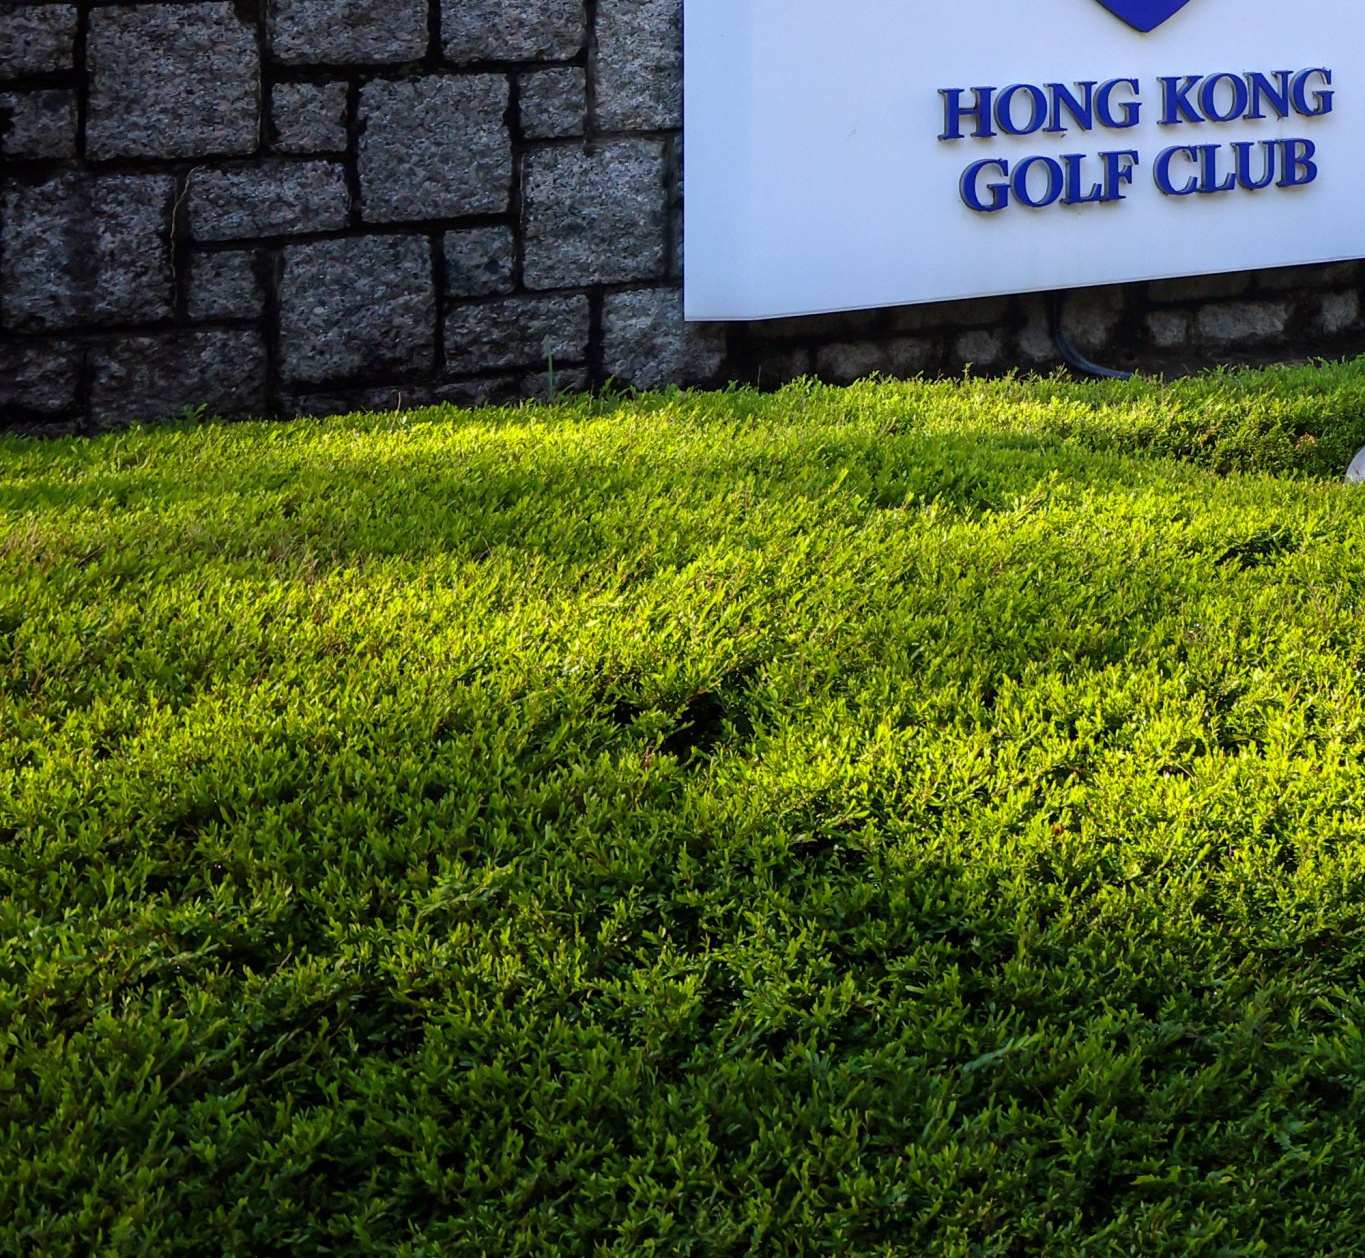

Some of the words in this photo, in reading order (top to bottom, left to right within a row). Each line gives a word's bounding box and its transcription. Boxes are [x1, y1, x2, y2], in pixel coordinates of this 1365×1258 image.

[938, 78, 1142, 141] HONG
[1157, 67, 1335, 126] KONG
[960, 150, 1140, 213] GOLF
[1153, 137, 1318, 197] CLUB
